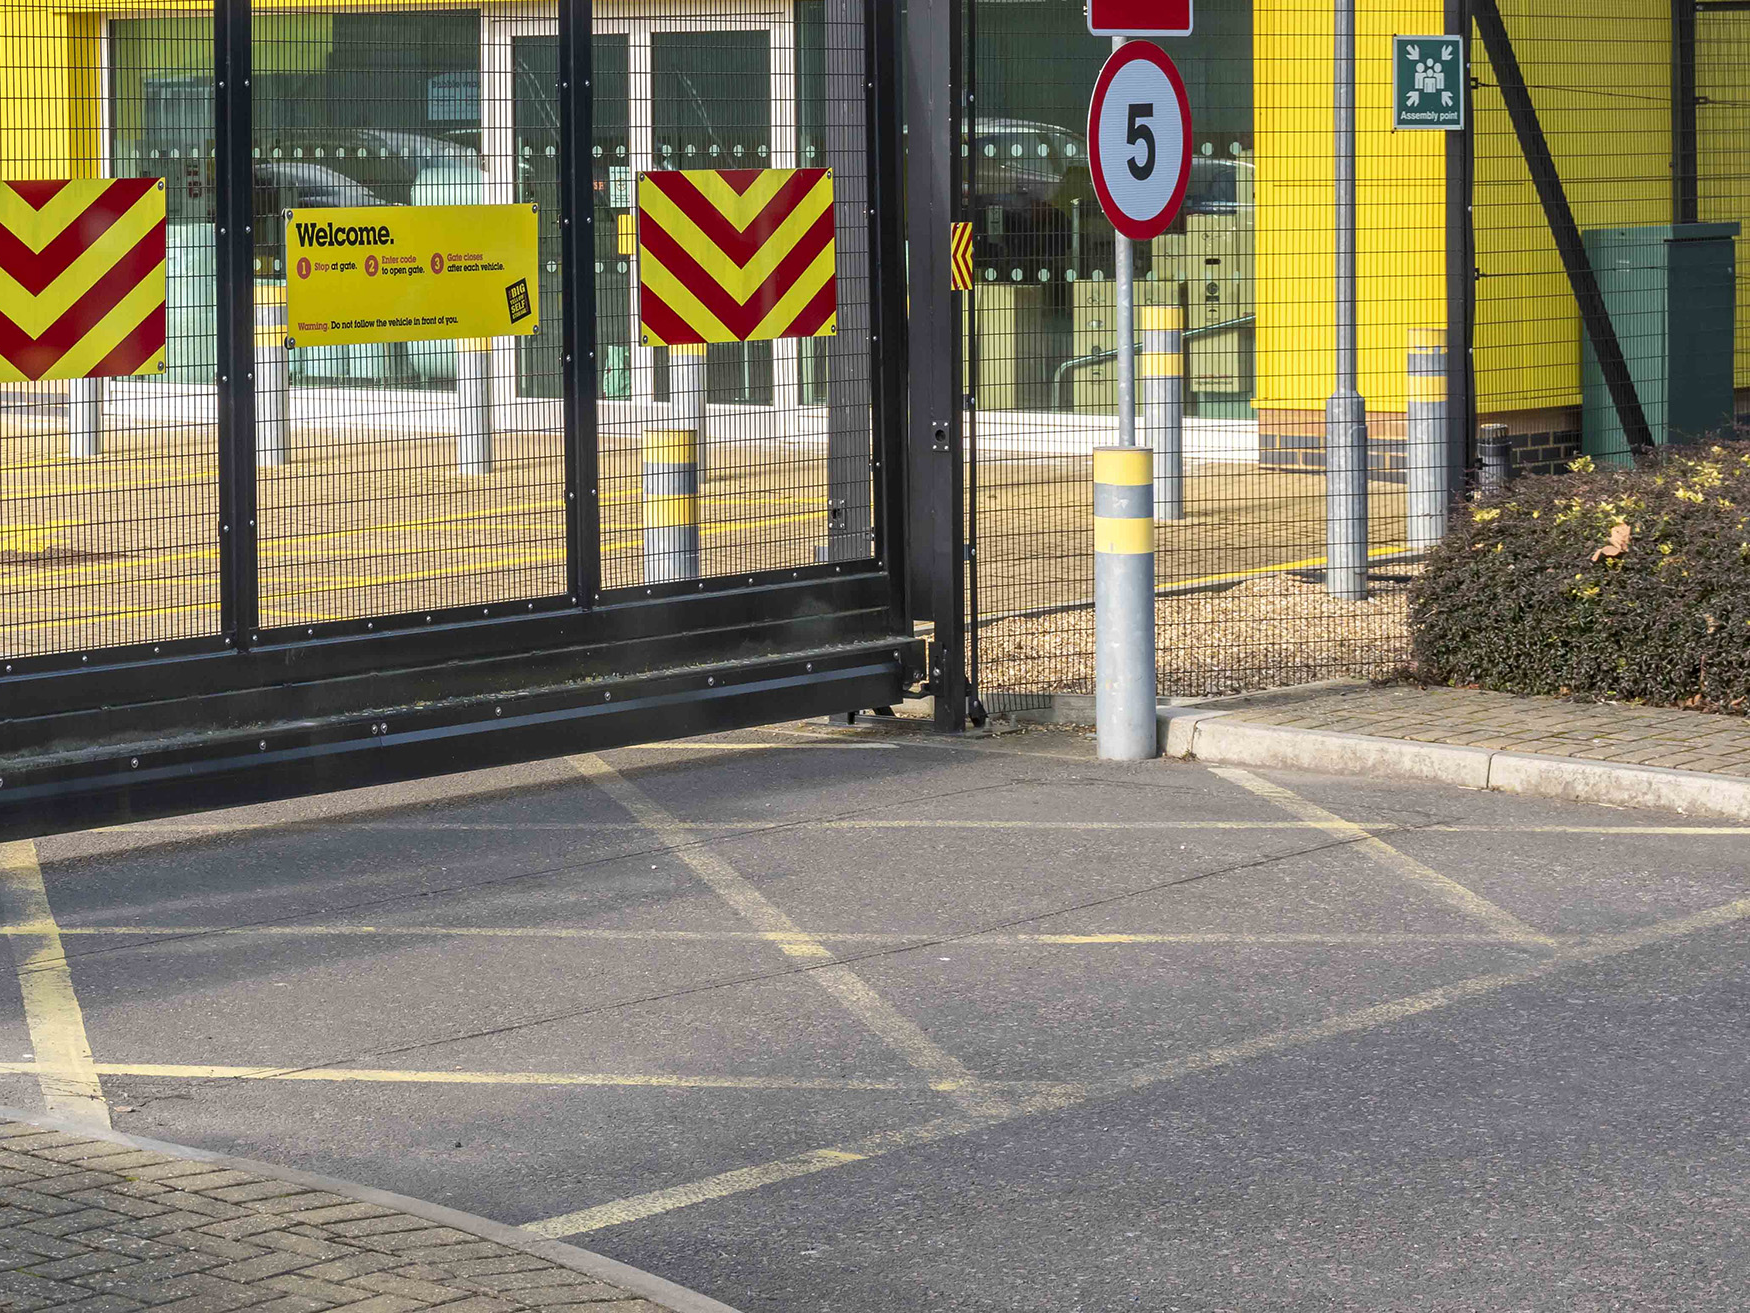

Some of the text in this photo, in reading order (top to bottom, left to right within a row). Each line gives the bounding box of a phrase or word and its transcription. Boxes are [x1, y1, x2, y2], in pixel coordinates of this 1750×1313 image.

[1400, 111, 1458, 122] Assembly point
[1126, 102, 1156, 181] 5
[296, 222, 394, 248] Welcome.
[382, 256, 399, 265] Enter
[400, 255, 416, 264] code
[447, 253, 462, 262] Gate
[463, 253, 483, 261] closes
[314, 263, 330, 272] Stop
[339, 262, 357, 272] gate.
[382, 265, 425, 276] to open gate.
[447, 262, 505, 272] after each vehicle.
[511, 283, 526, 298] BIG
[511, 299, 526, 314] SELF
[298, 315, 458, 332] Warning. Do not follow the vehicle in front of you.
